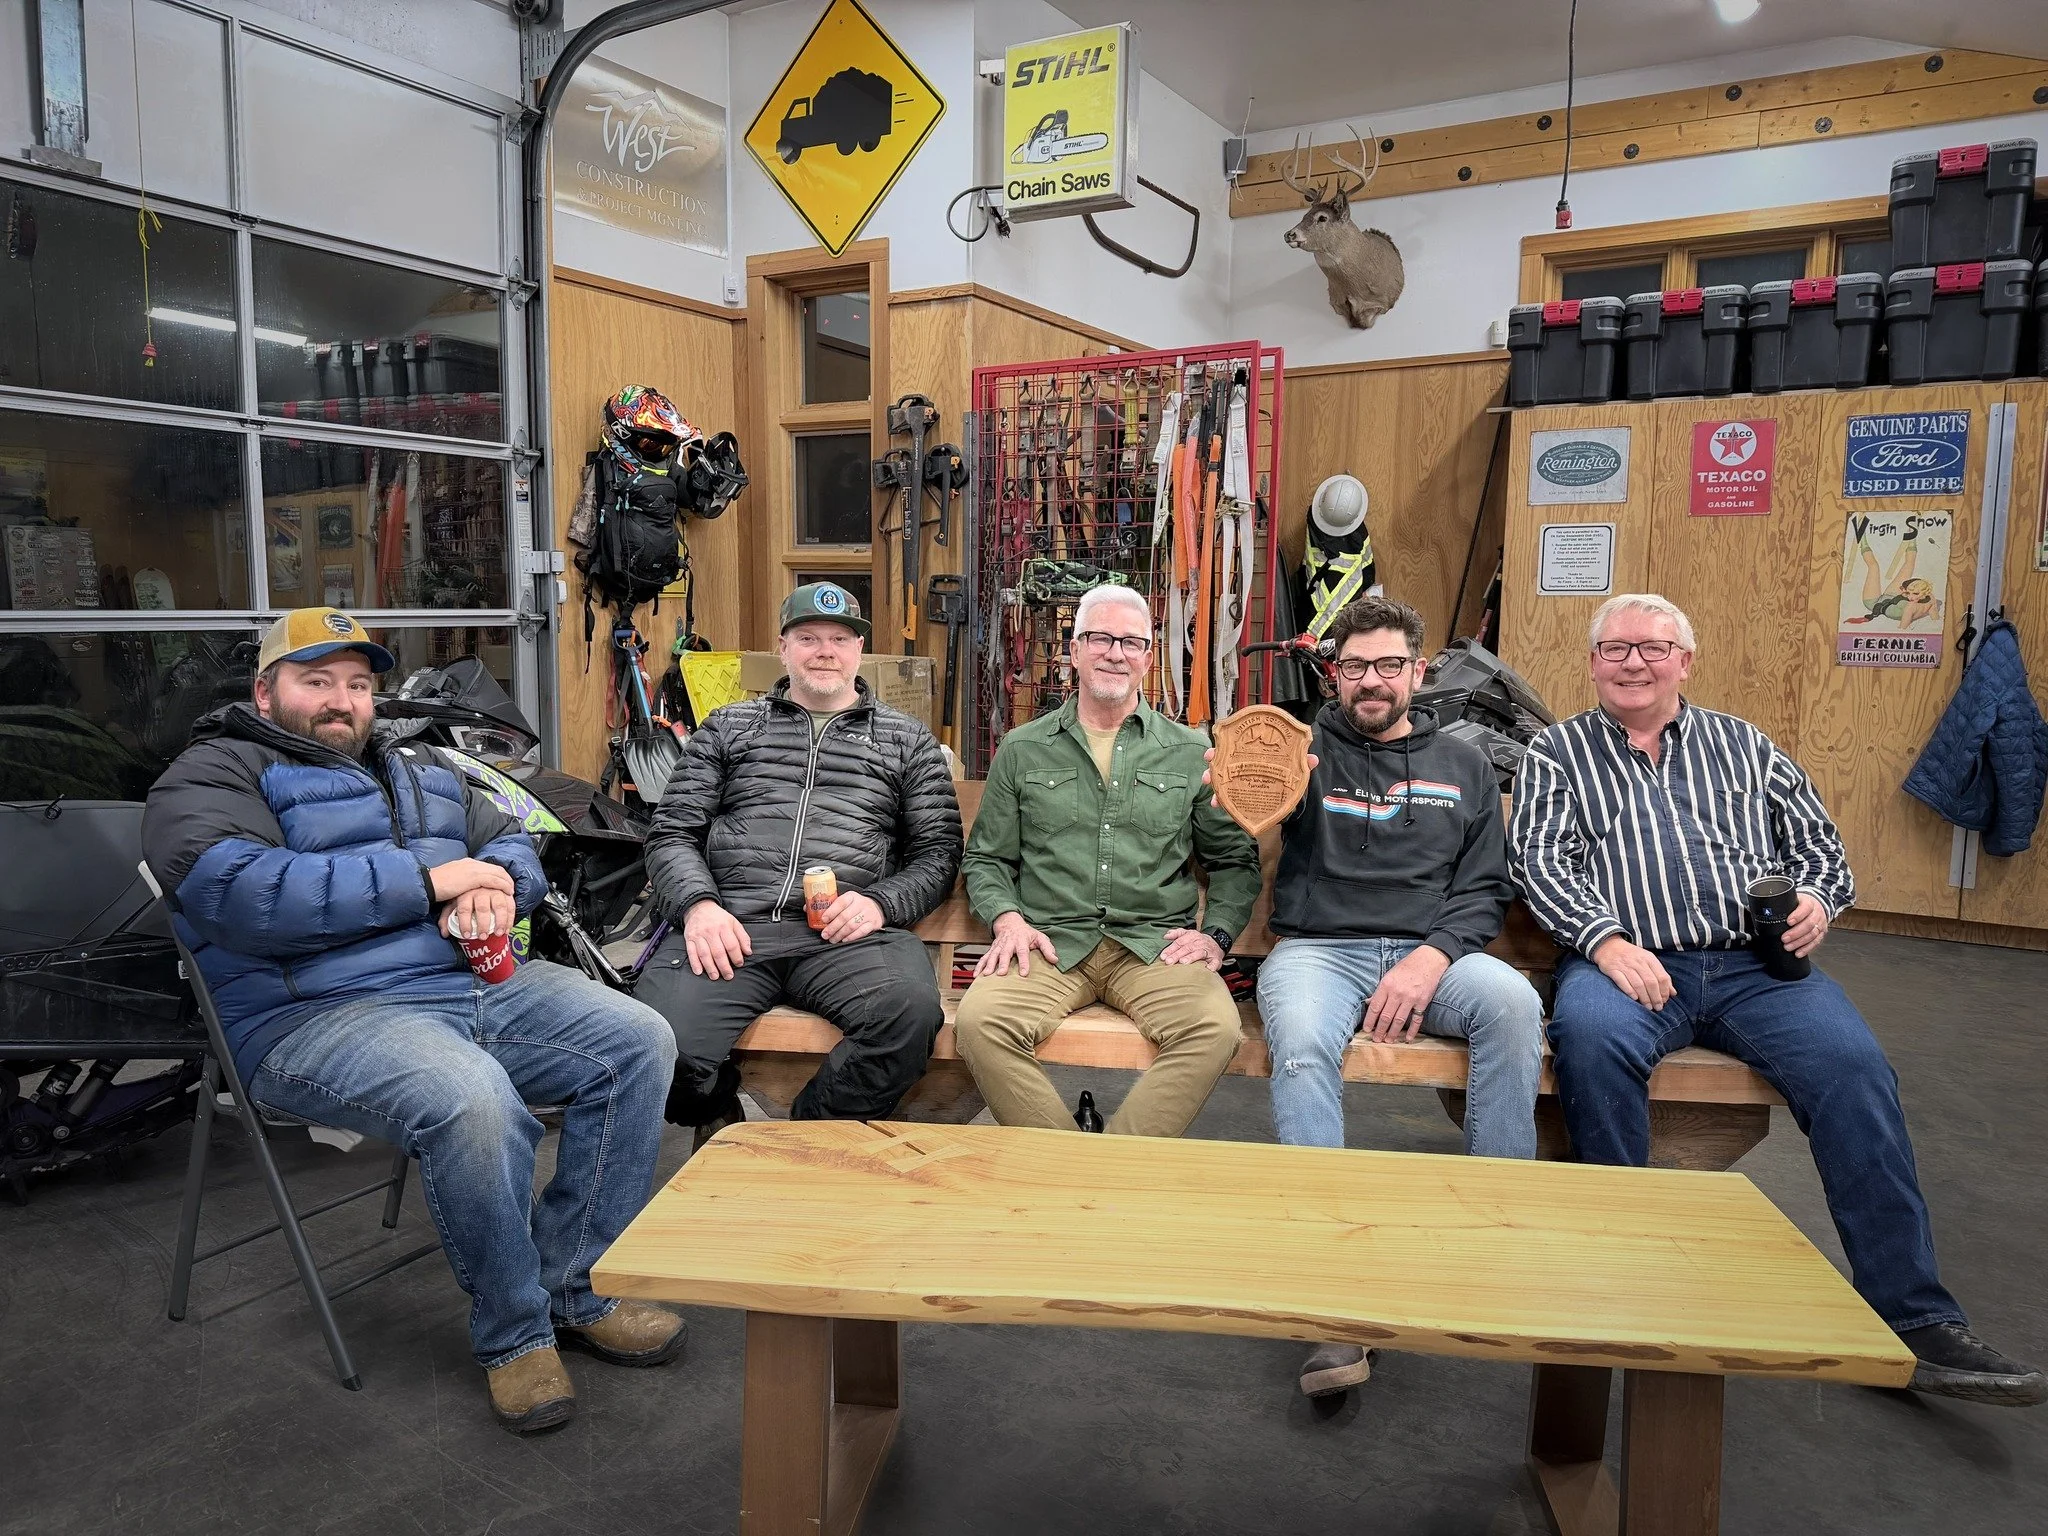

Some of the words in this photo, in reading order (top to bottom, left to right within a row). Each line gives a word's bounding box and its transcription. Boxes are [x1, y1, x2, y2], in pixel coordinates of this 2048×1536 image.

[1012, 46, 1110, 88] STIHL
[585, 100, 697, 173] West
[576, 160, 708, 215] CONSTRUCTION
[1007, 177, 1056, 201] Chain
[1061, 172, 1111, 193] Saws
[576, 187, 587, 201] &
[589, 191, 643, 218] PROJECT
[1716, 430, 1753, 439] TEXACO
[1849, 417, 1916, 438] GENUINE
[1920, 414, 1968, 434] PARTS
[1540, 455, 1618, 474] Remington
[1871, 442, 1940, 468] Ford
[1697, 469, 1767, 484] TEXACO
[1847, 479, 1900, 493] USED
[1904, 476, 1961, 491] HERE
[1707, 500, 1755, 508] GASOLINE
[1851, 515, 1897, 545] Virgin
[1902, 515, 1948, 541] Snow
[823, 595, 838, 606] FSA
[1853, 638, 1926, 650] FERNIE
[1840, 651, 1879, 662] BRITISH
[1883, 653, 1936, 664] COLUMBIA
[458, 941, 491, 959] Tim
